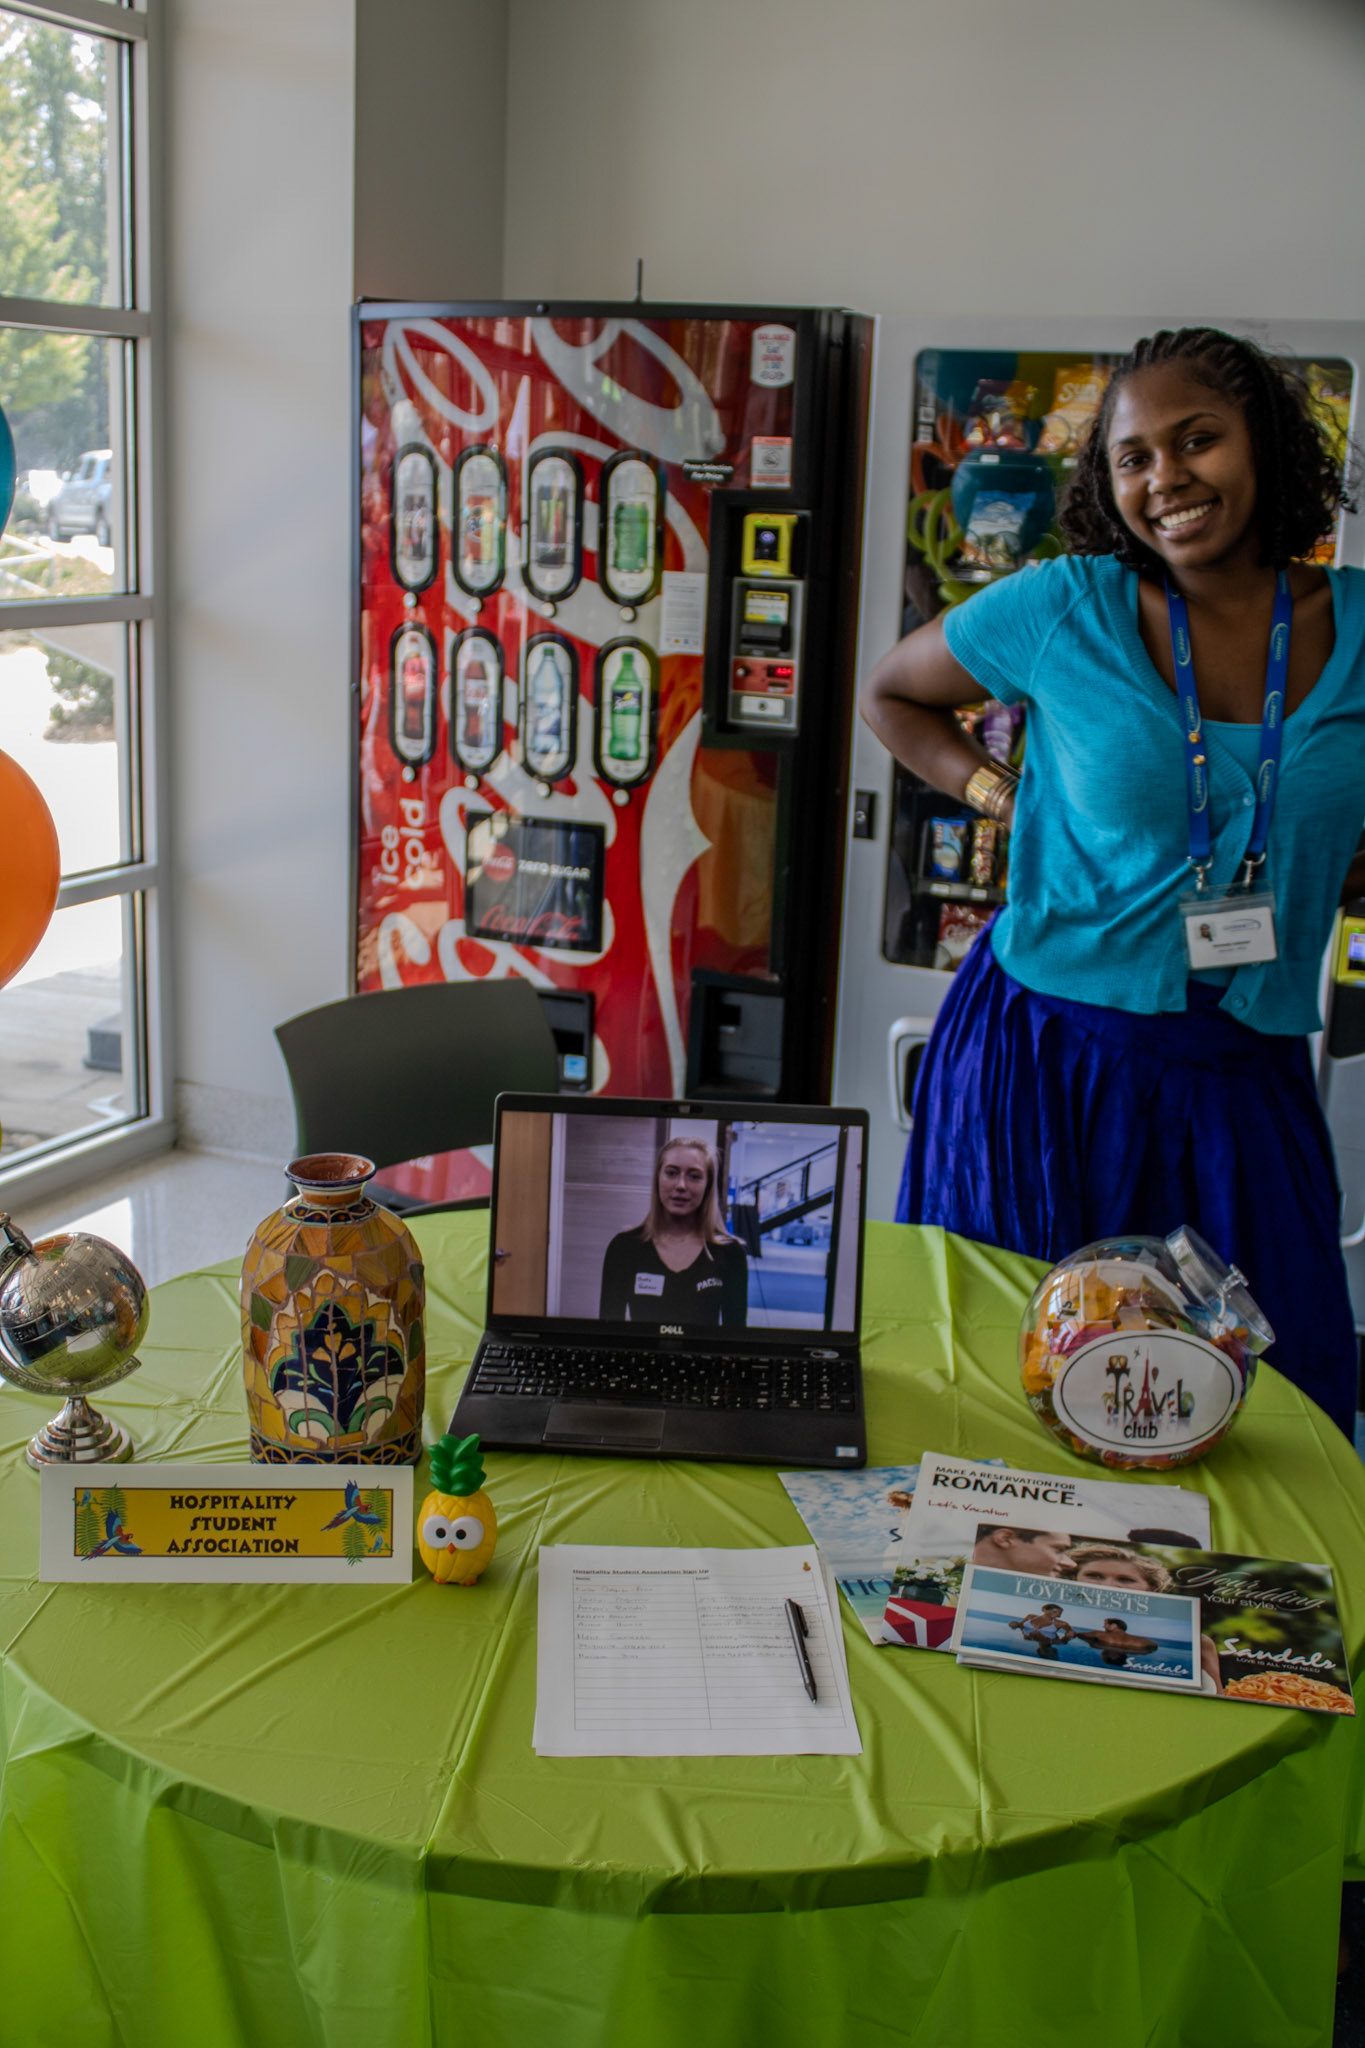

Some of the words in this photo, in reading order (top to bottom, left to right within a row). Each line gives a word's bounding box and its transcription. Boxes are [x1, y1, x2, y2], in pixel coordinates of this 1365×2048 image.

[400, 799, 426, 890] cold
[372, 825, 399, 885] ice
[550, 863, 591, 881] SUGAR
[660, 1325, 684, 1335] DELL
[1104, 1349, 1192, 1418] TRAVEL
[1123, 1421, 1159, 1439] club
[936, 1466, 967, 1476] MAKE
[969, 1470, 978, 1478] A
[980, 1472, 1051, 1487] RESERVATION
[1054, 1482, 1076, 1491] FOR
[932, 1473, 1083, 1507] ROMANCE.
[169, 1494, 298, 1510] HOSPITALITY
[928, 1499, 958, 1510] Let's
[962, 1503, 1009, 1517] Vacation
[190, 1516, 277, 1531] STUDENT
[166, 1538, 300, 1554] ASSOCIATION
[1016, 1580, 1073, 1603] LOVE
[1079, 1590, 1150, 1613] NESTS
[1203, 1593, 1236, 1605] Your
[1240, 1599, 1278, 1611] style.
[1219, 1637, 1336, 1669] Sandals
[1122, 1657, 1189, 1675] Sandals
[1235, 1656, 1256, 1665] LOVE
[1266, 1661, 1281, 1669] ALL
[1299, 1666, 1322, 1674] NEED
